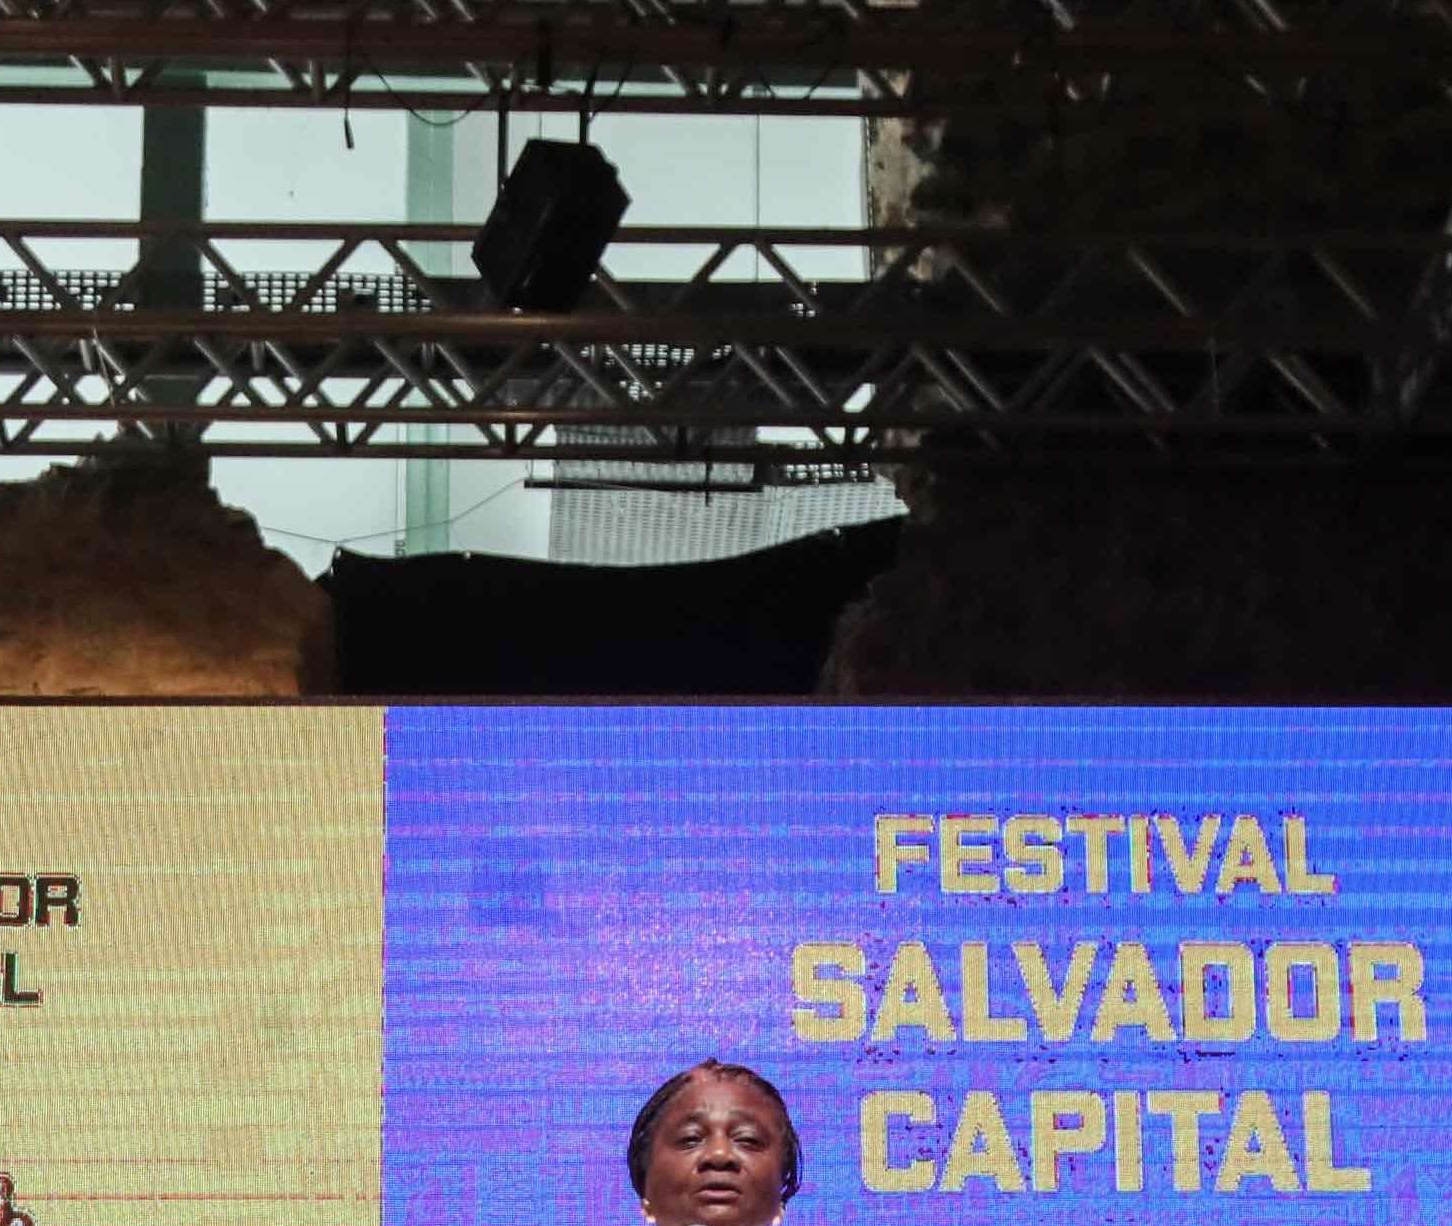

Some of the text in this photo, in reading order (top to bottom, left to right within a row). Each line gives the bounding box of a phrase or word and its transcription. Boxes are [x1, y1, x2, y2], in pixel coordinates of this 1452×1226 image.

[874, 814, 1337, 894] FESTIVAL
[790, 941, 1427, 1042] SALVADOR
[861, 1090, 1372, 1192] CAPITAL
